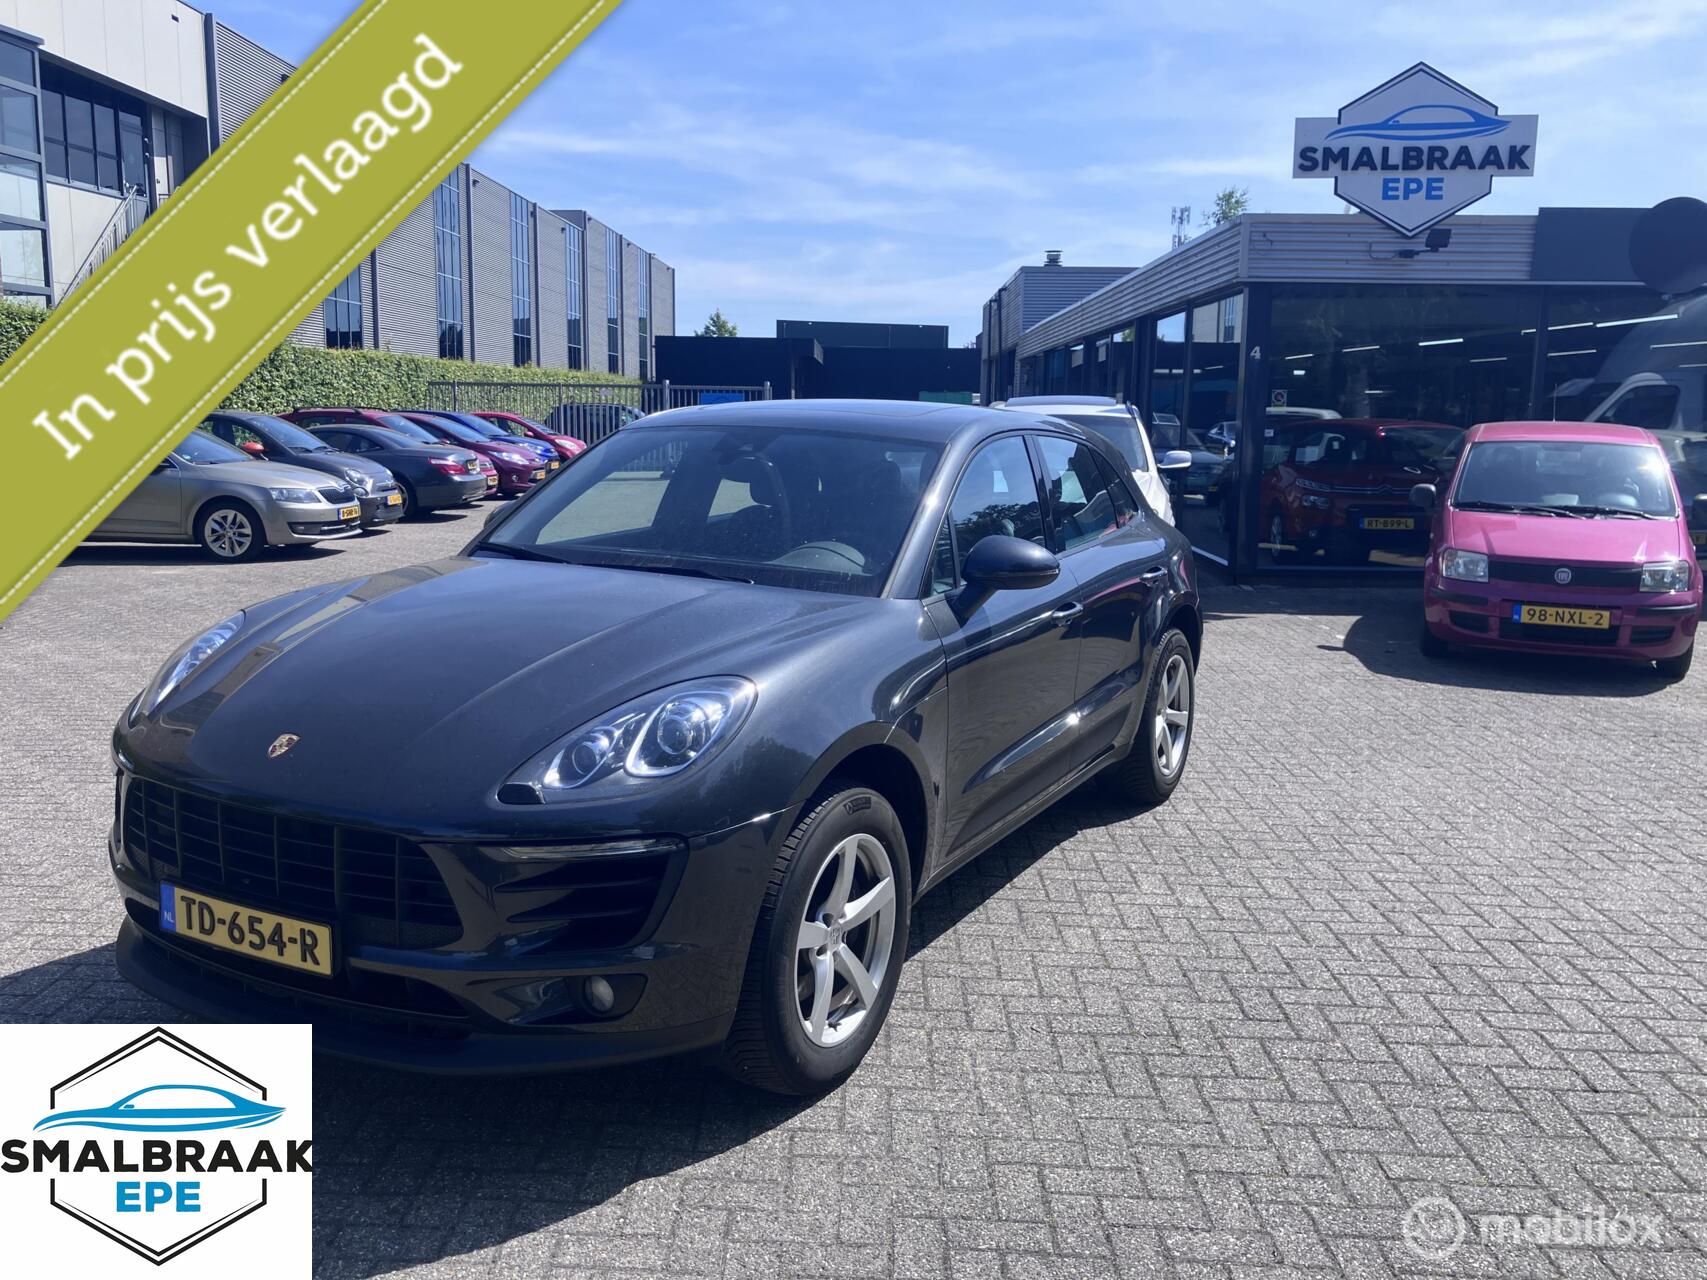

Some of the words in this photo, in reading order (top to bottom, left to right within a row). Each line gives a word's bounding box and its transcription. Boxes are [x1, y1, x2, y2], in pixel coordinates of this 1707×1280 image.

[1298, 145, 1531, 172] SMALBRAAK
[1381, 177, 1445, 200] EPE
[1249, 346, 1261, 359] 4
[1527, 608, 1604, 626] 98-NXL-2
[164, 911, 175, 924] NL
[180, 895, 321, 967] TD-654-R
